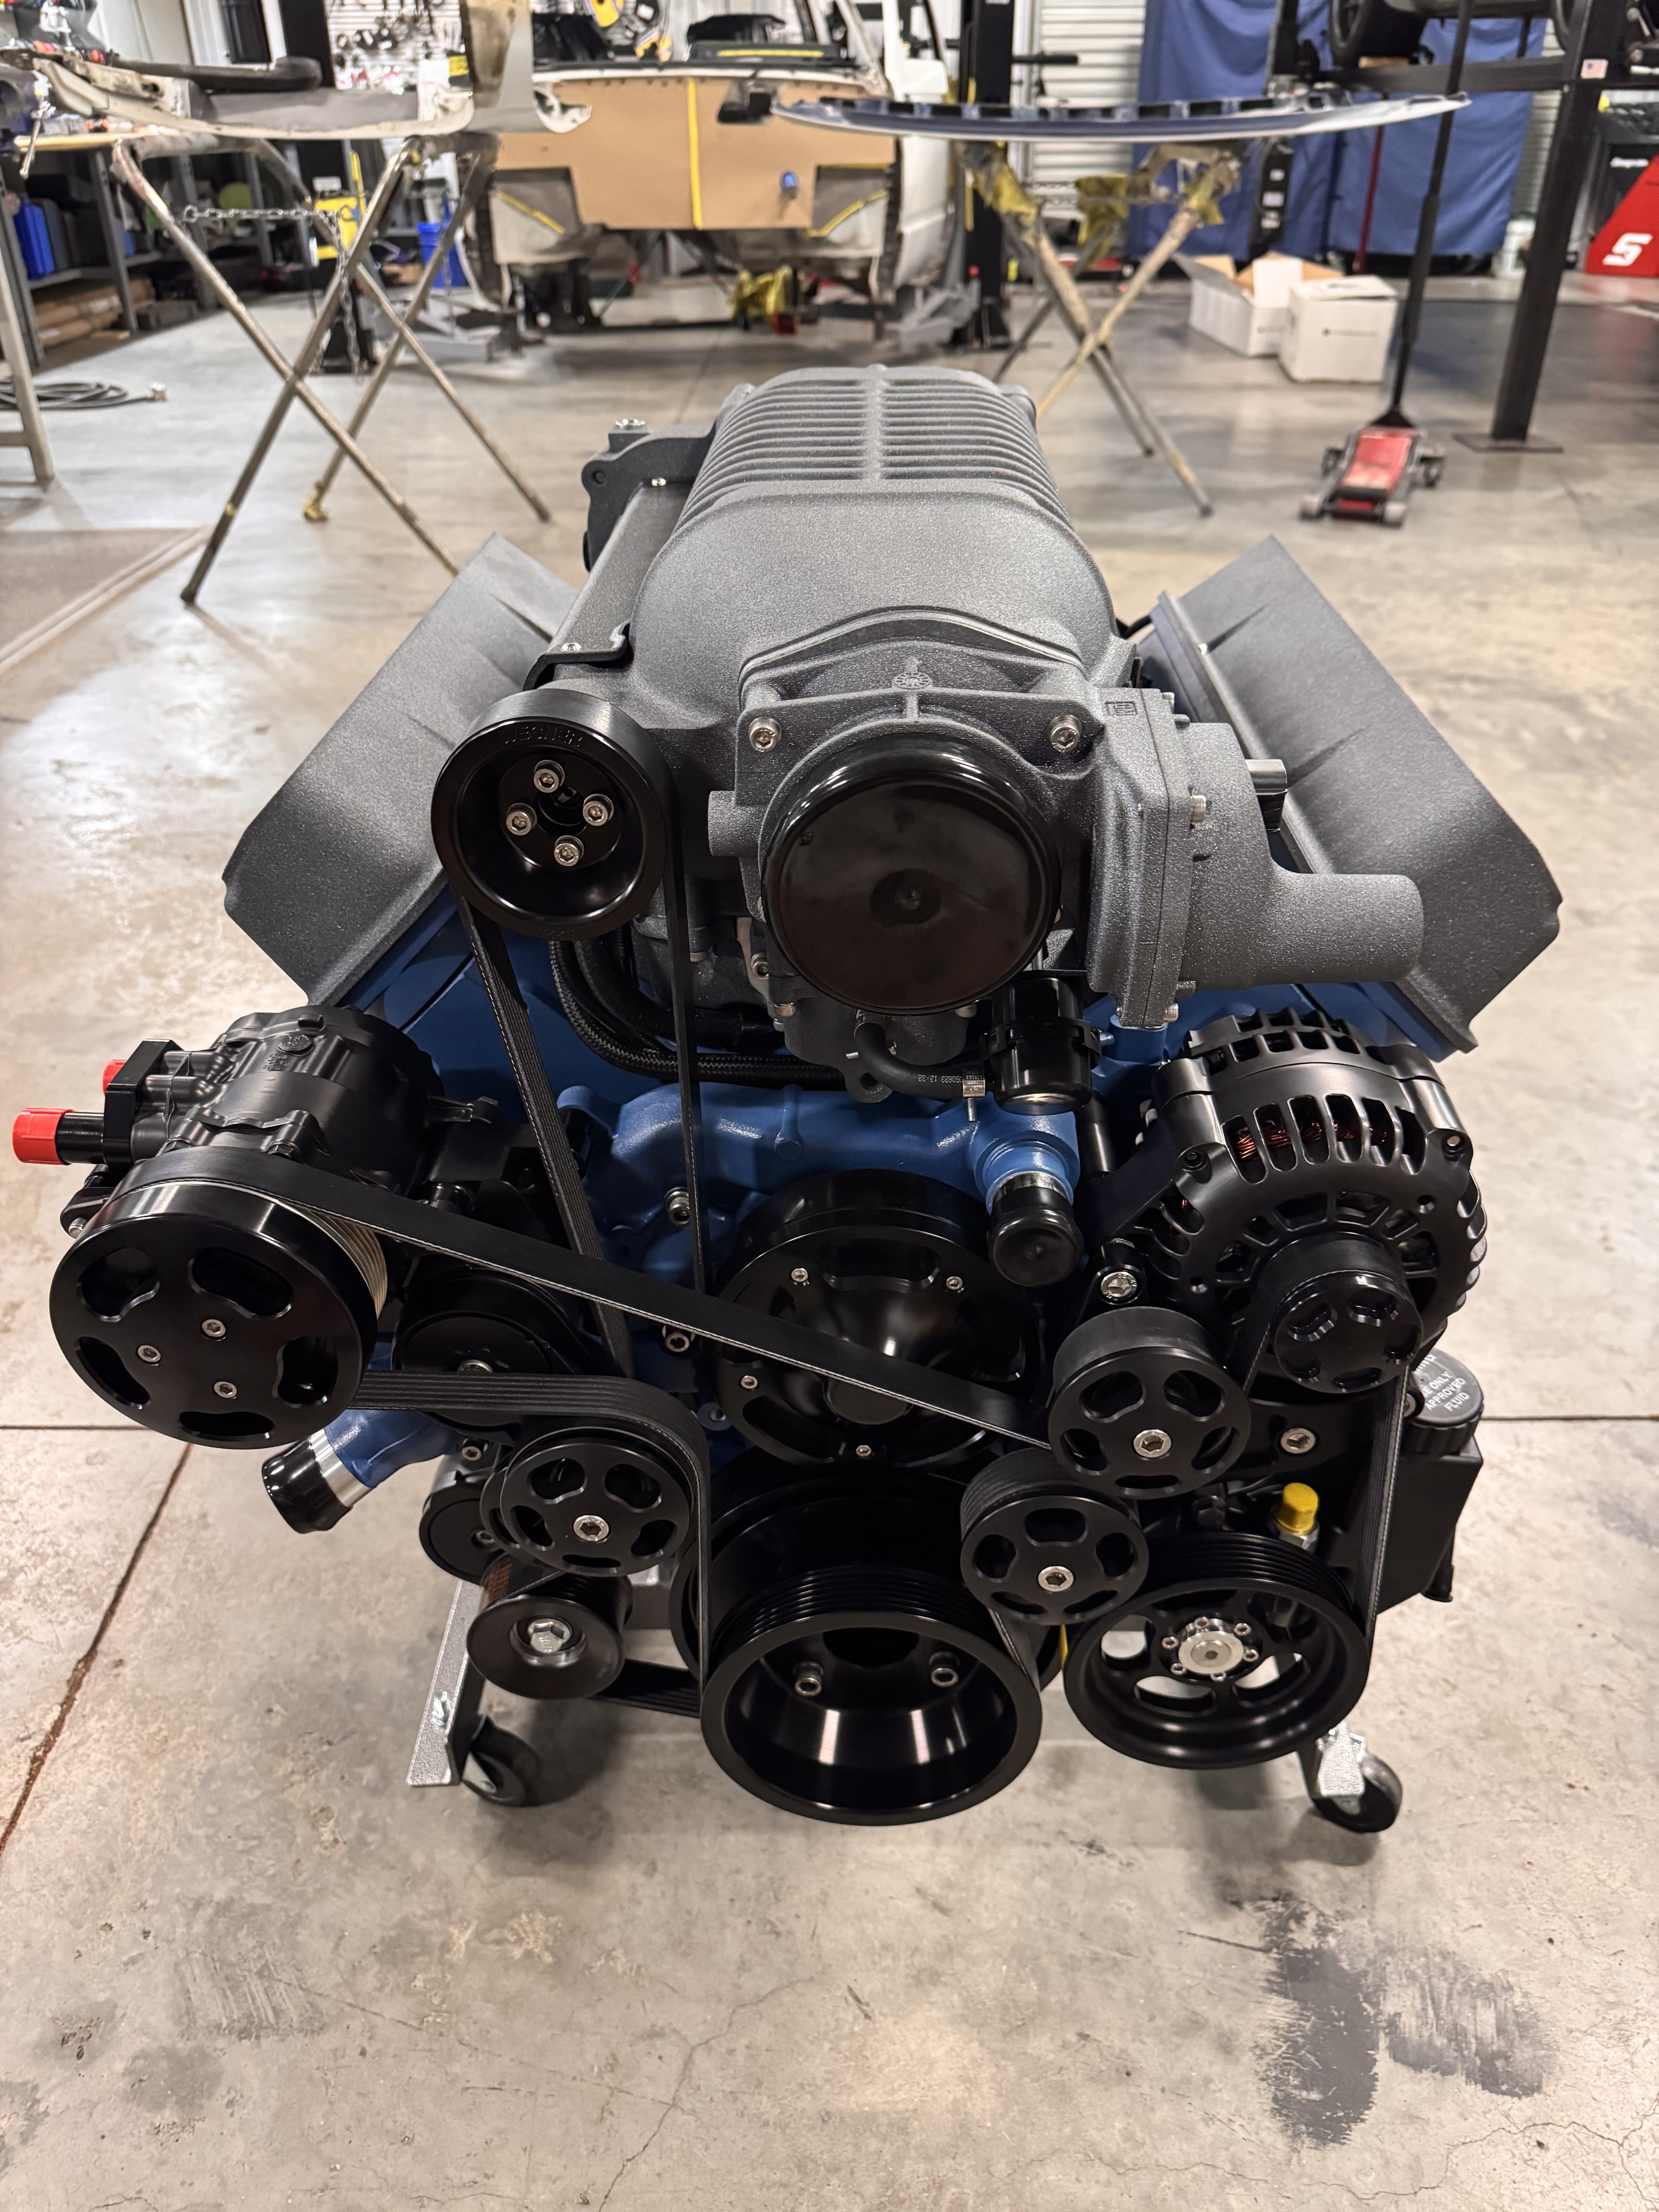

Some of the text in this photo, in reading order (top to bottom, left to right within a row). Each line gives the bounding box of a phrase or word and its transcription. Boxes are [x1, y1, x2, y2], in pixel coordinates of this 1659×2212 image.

[918, 1074, 937, 1082] 12:32
[1429, 1371, 1452, 1389] ONLY
[1425, 1377, 1466, 1410] APPROVED
[1443, 1392, 1469, 1412] FLUID
